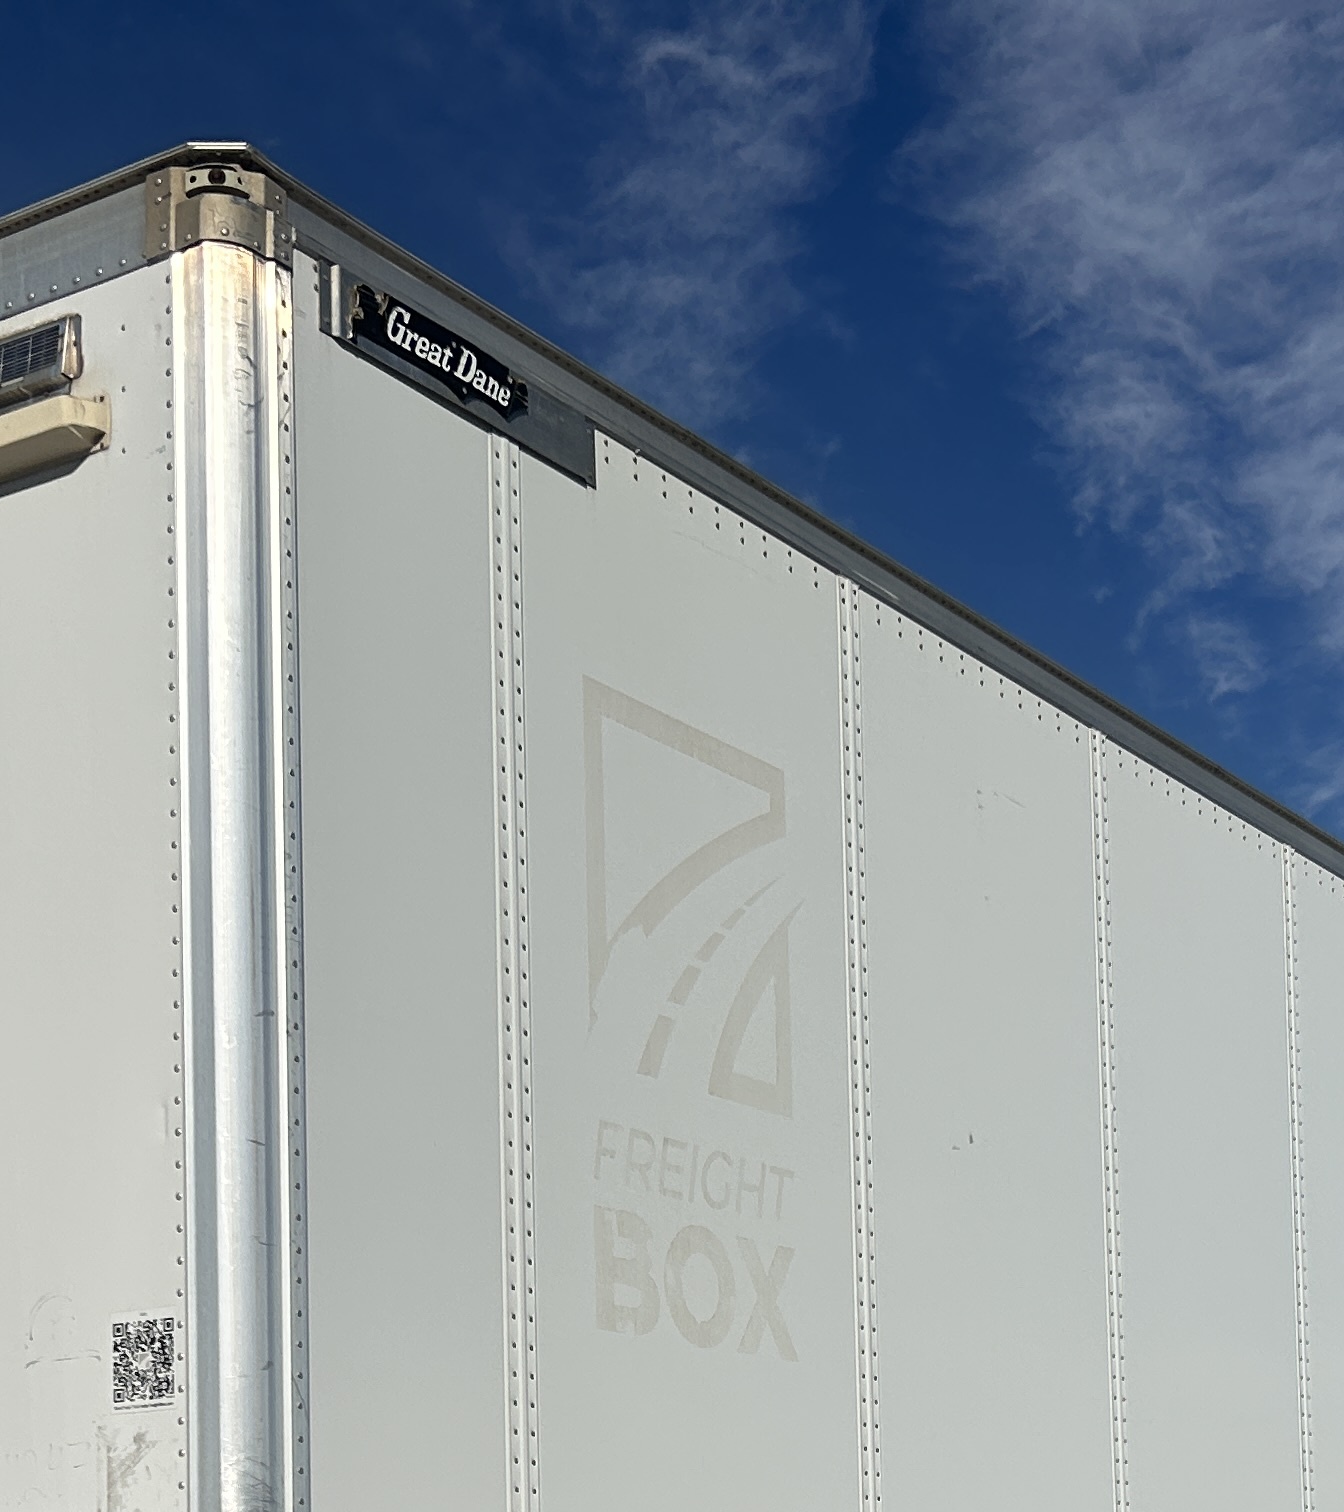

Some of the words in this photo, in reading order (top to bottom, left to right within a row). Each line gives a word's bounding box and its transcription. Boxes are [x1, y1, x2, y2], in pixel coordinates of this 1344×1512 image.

[386, 305, 454, 373] Great
[453, 345, 512, 407] Dane
[592, 1118, 796, 1222] FREIGHT
[593, 1203, 800, 1363] BOX
